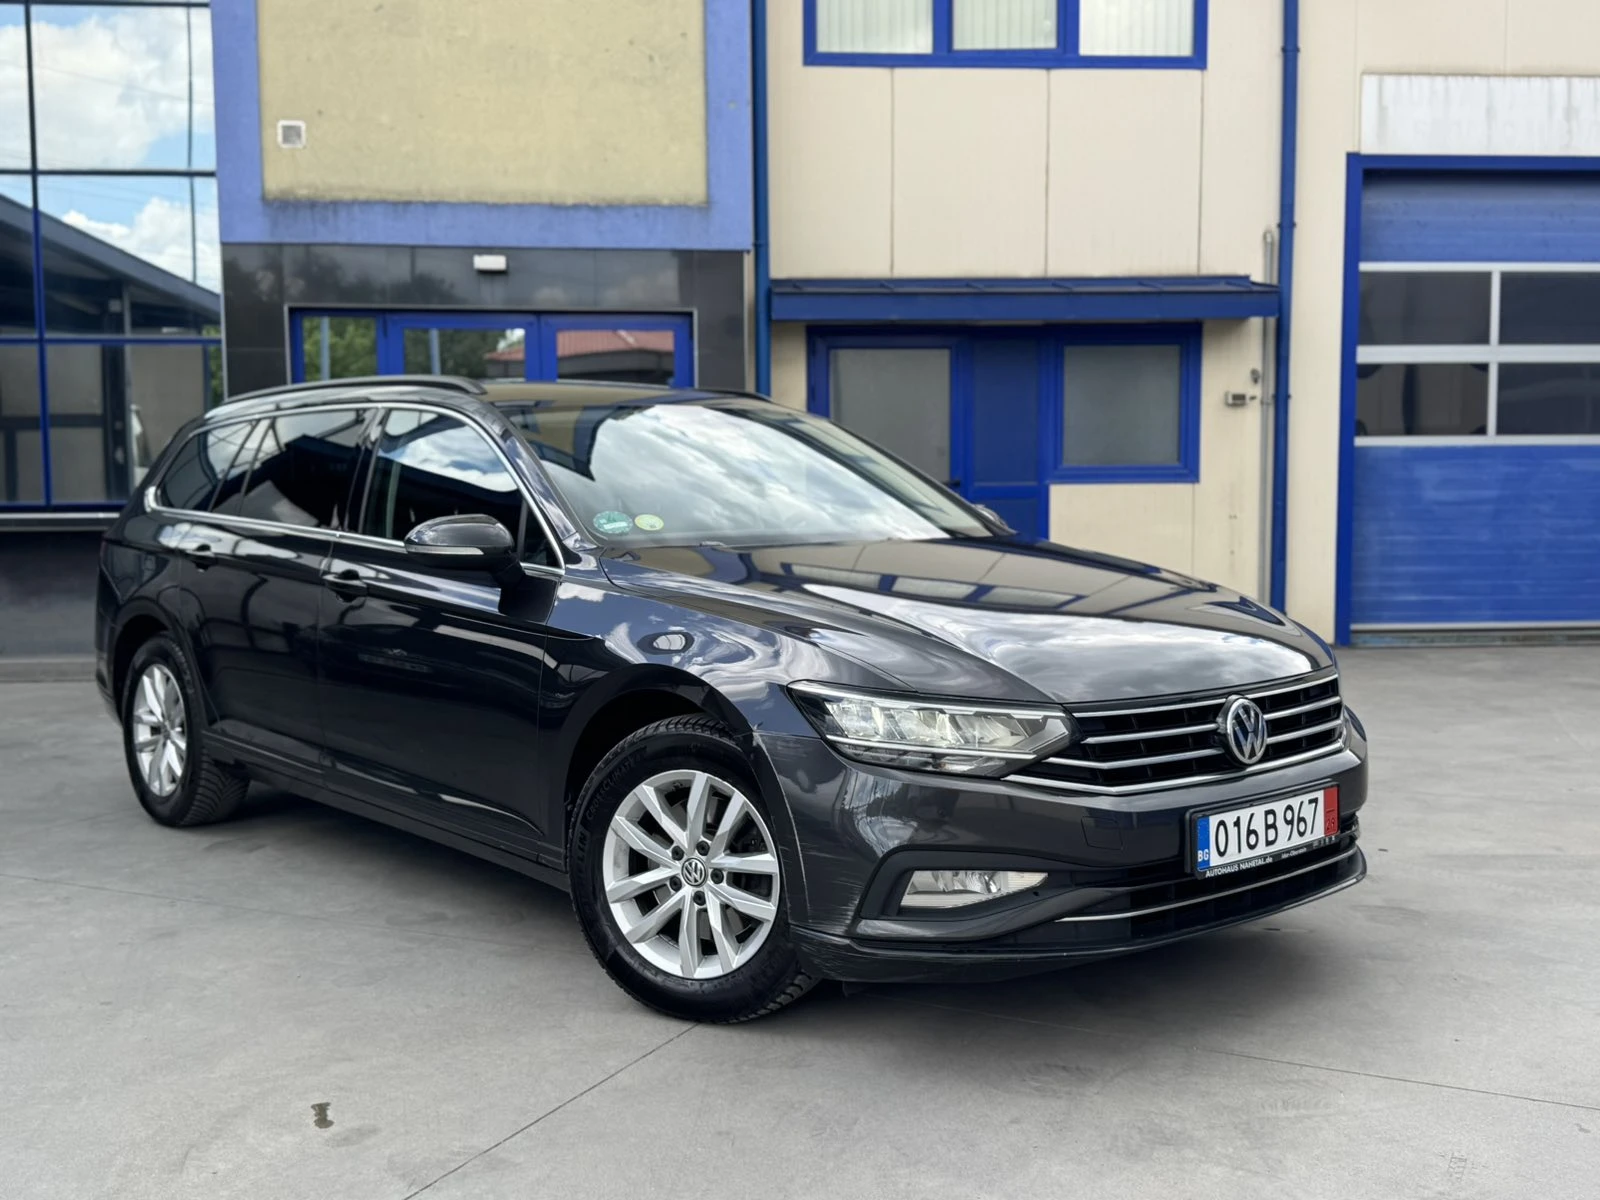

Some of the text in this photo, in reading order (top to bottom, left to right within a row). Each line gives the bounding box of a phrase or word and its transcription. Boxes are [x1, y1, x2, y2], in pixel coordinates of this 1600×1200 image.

[1228, 699, 1266, 763] VW
[1197, 849, 1209, 862] BG
[1205, 863, 1239, 878] AUTOHAUS
